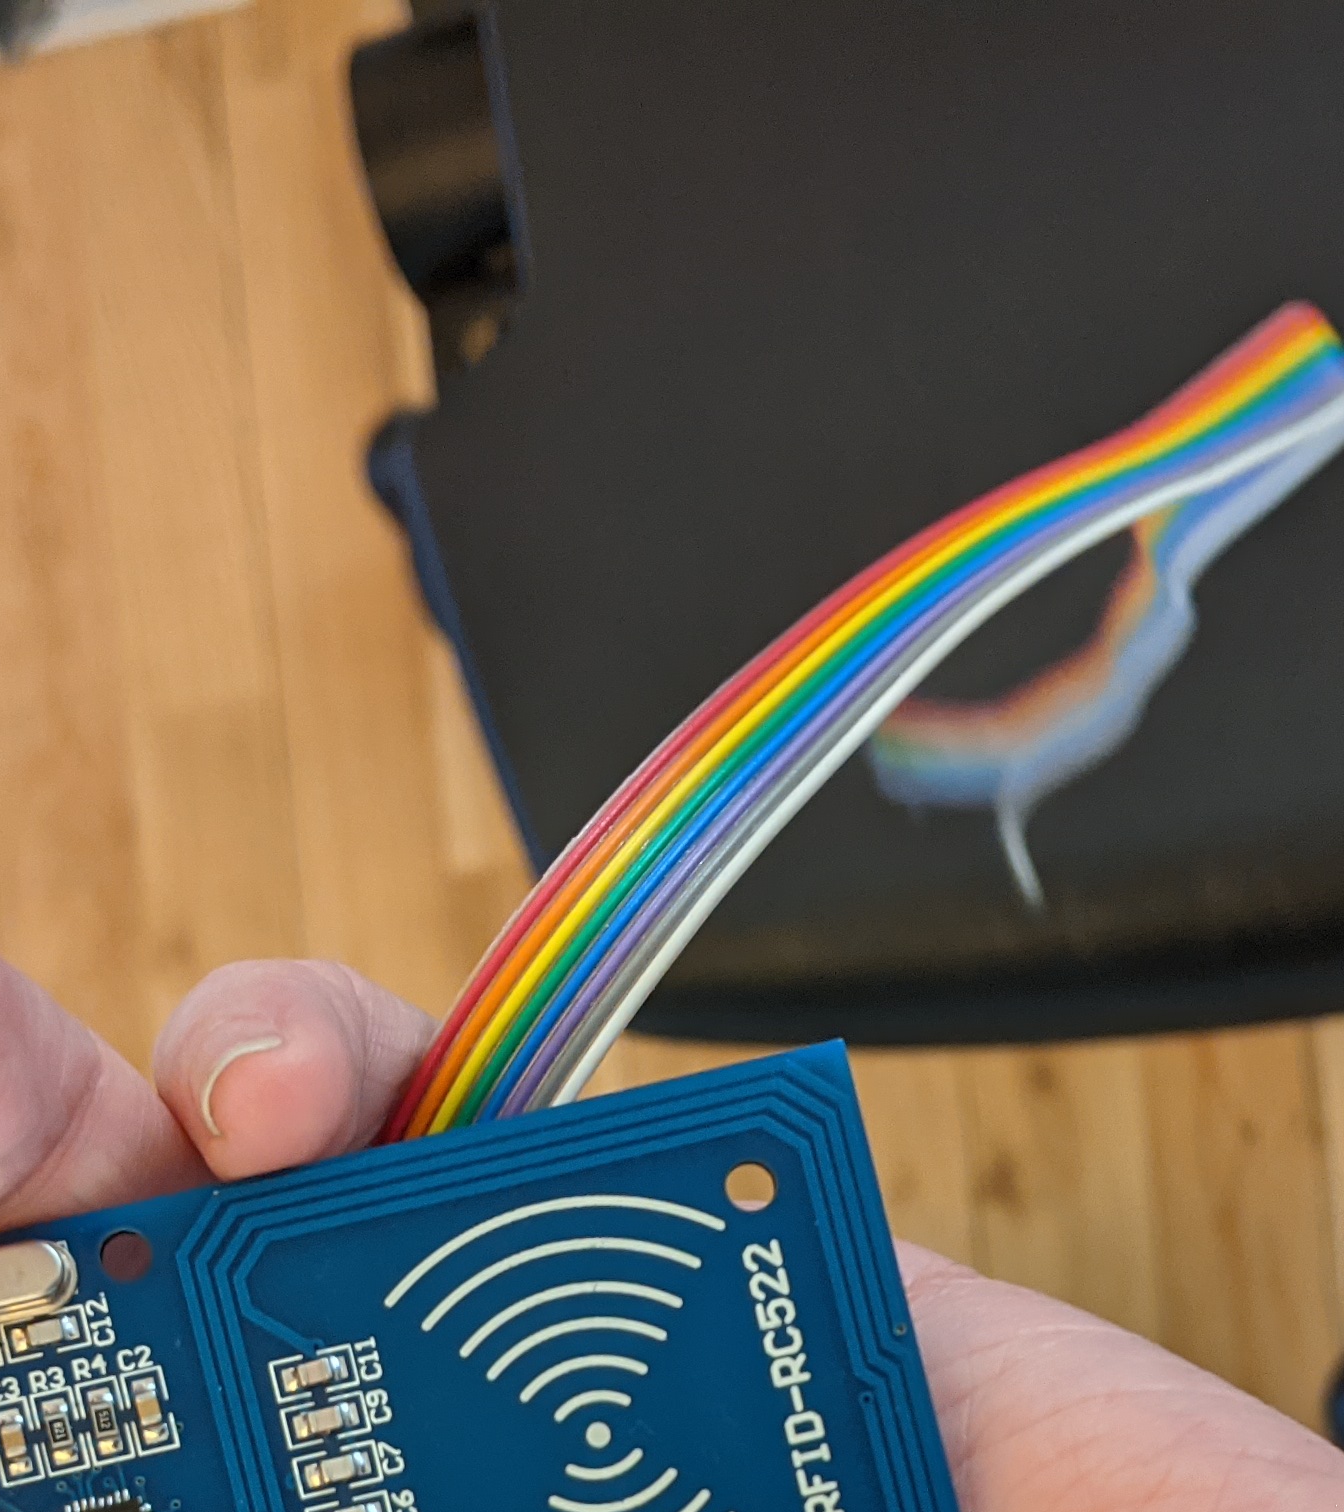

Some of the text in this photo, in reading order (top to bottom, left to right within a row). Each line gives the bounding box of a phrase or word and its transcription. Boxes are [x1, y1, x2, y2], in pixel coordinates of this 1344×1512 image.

[85, 1291, 116, 1347] C12
[28, 1366, 66, 1393] R3
[71, 1353, 107, 1381] R4
[116, 1345, 154, 1372] C2
[354, 1336, 383, 1382] C11
[366, 1388, 393, 1425] C9
[378, 1441, 405, 1475] C7
